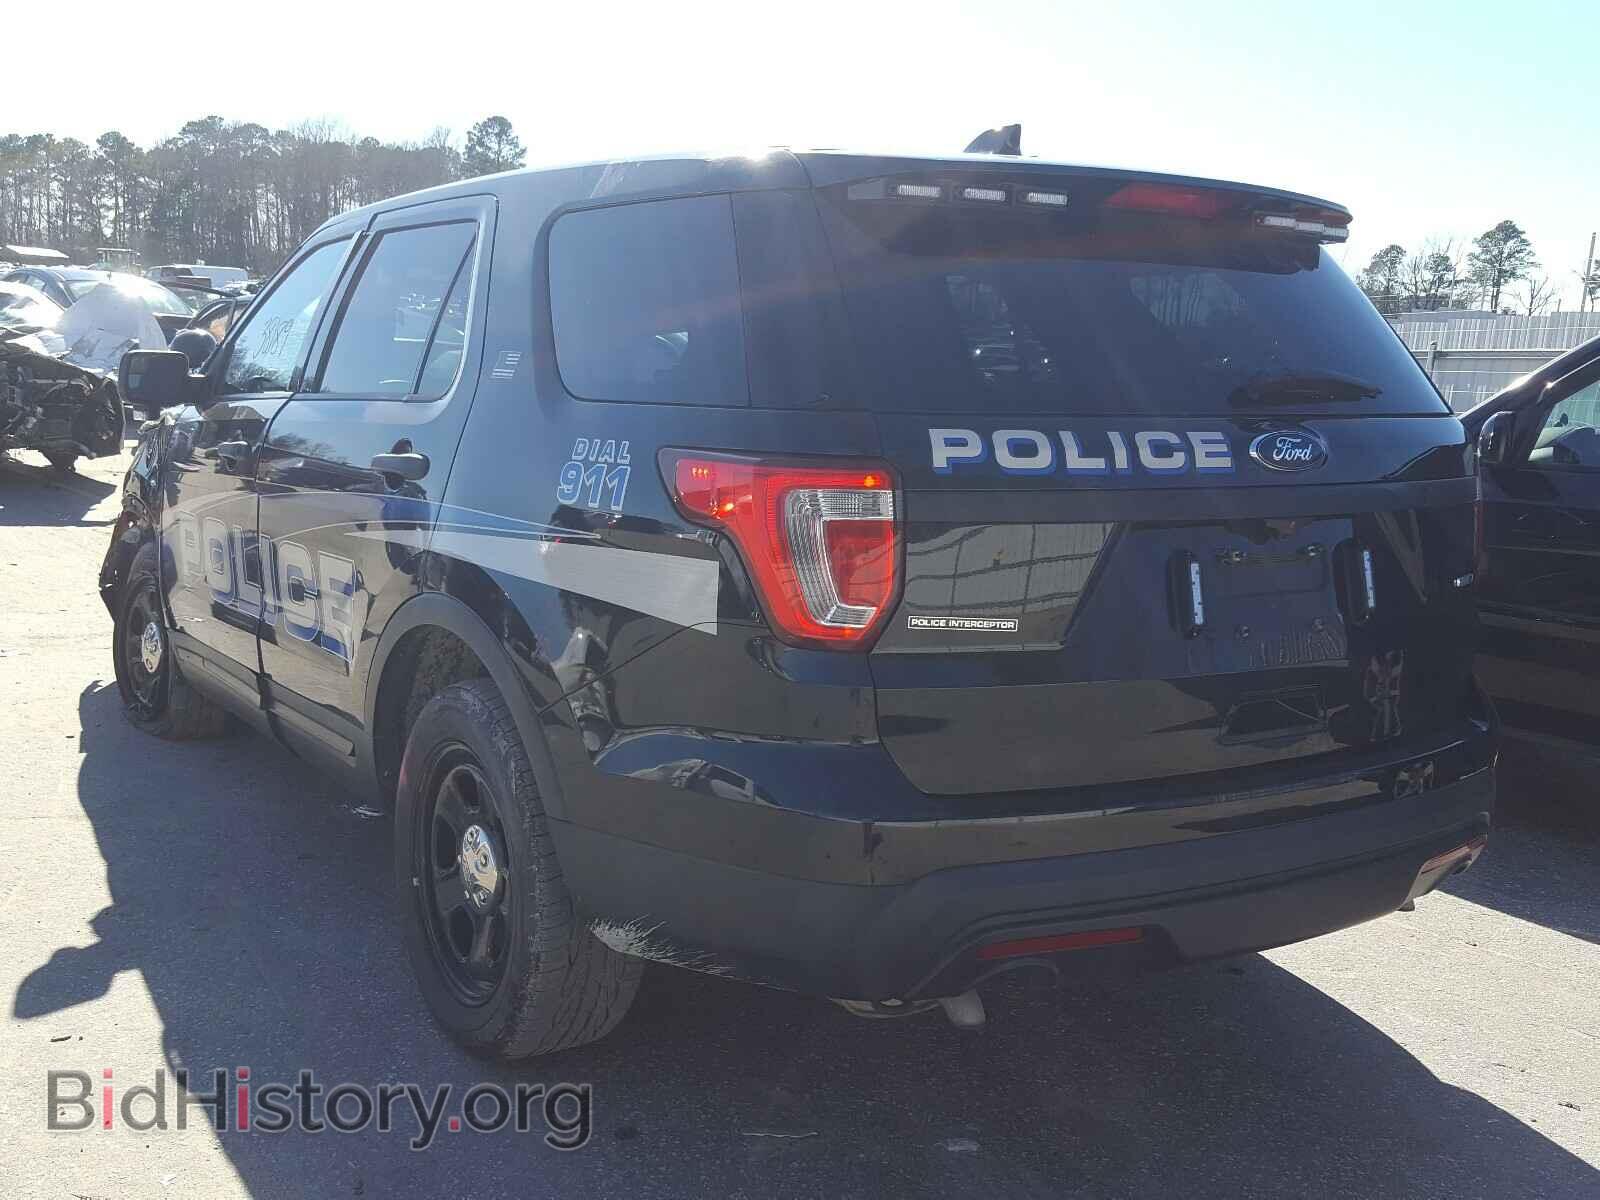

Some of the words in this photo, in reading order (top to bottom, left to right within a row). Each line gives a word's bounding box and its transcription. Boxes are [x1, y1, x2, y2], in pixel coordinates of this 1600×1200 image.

[572, 438, 632, 465] DIAL
[928, 427, 1236, 475] POLICE
[1272, 436, 1313, 462] Ford
[556, 461, 631, 511] 911
[172, 509, 358, 664] POLICE
[911, 618, 946, 627] POLICE
[949, 619, 1015, 629] INTERCEPTOR
